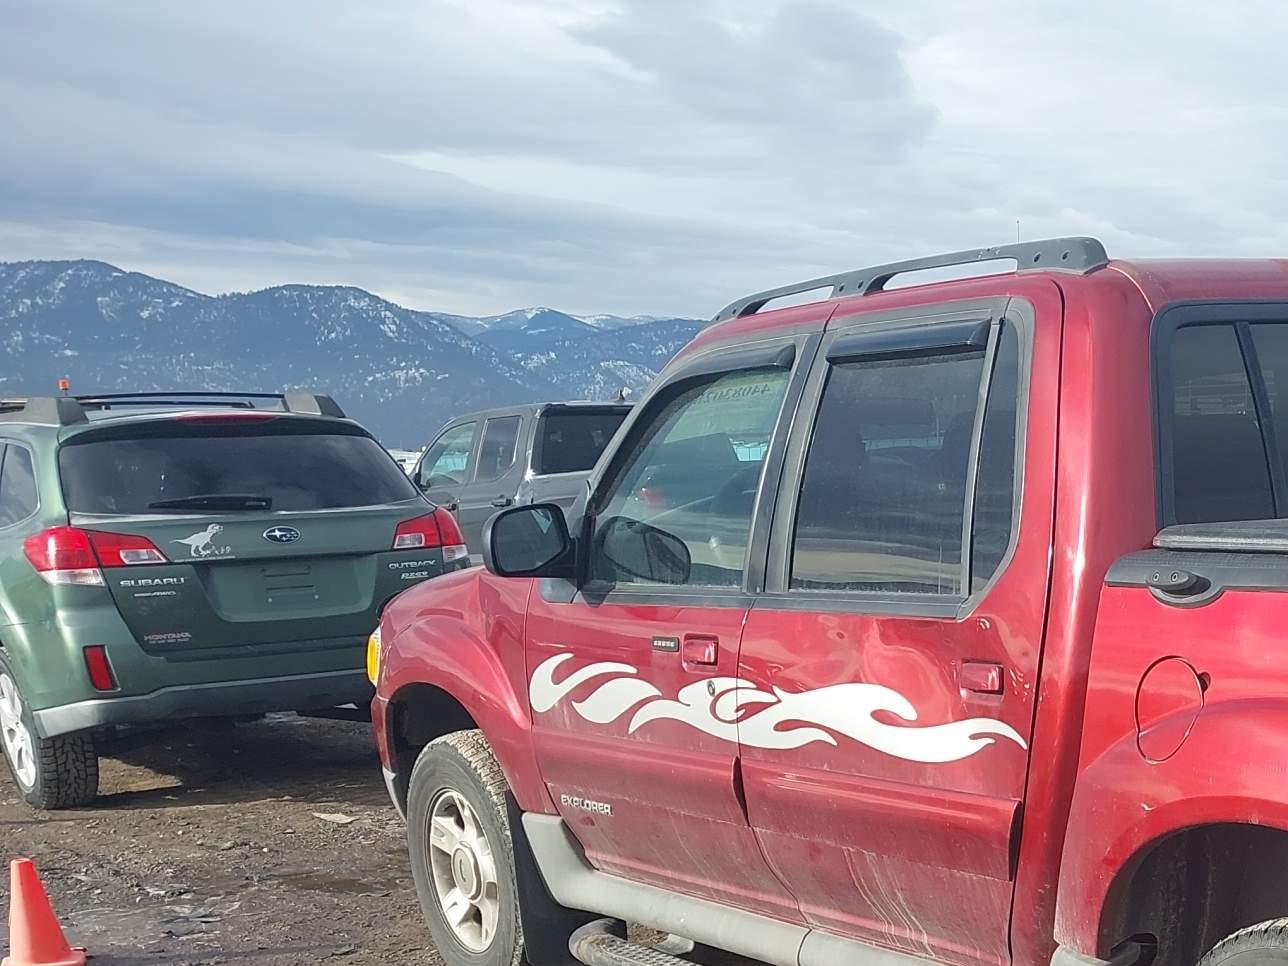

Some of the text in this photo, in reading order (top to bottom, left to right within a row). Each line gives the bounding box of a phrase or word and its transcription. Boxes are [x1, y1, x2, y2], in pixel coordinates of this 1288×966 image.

[388, 560, 436, 569] OUTBACK
[119, 577, 185, 587] SUBARU
[561, 794, 614, 816] EXPLORER
